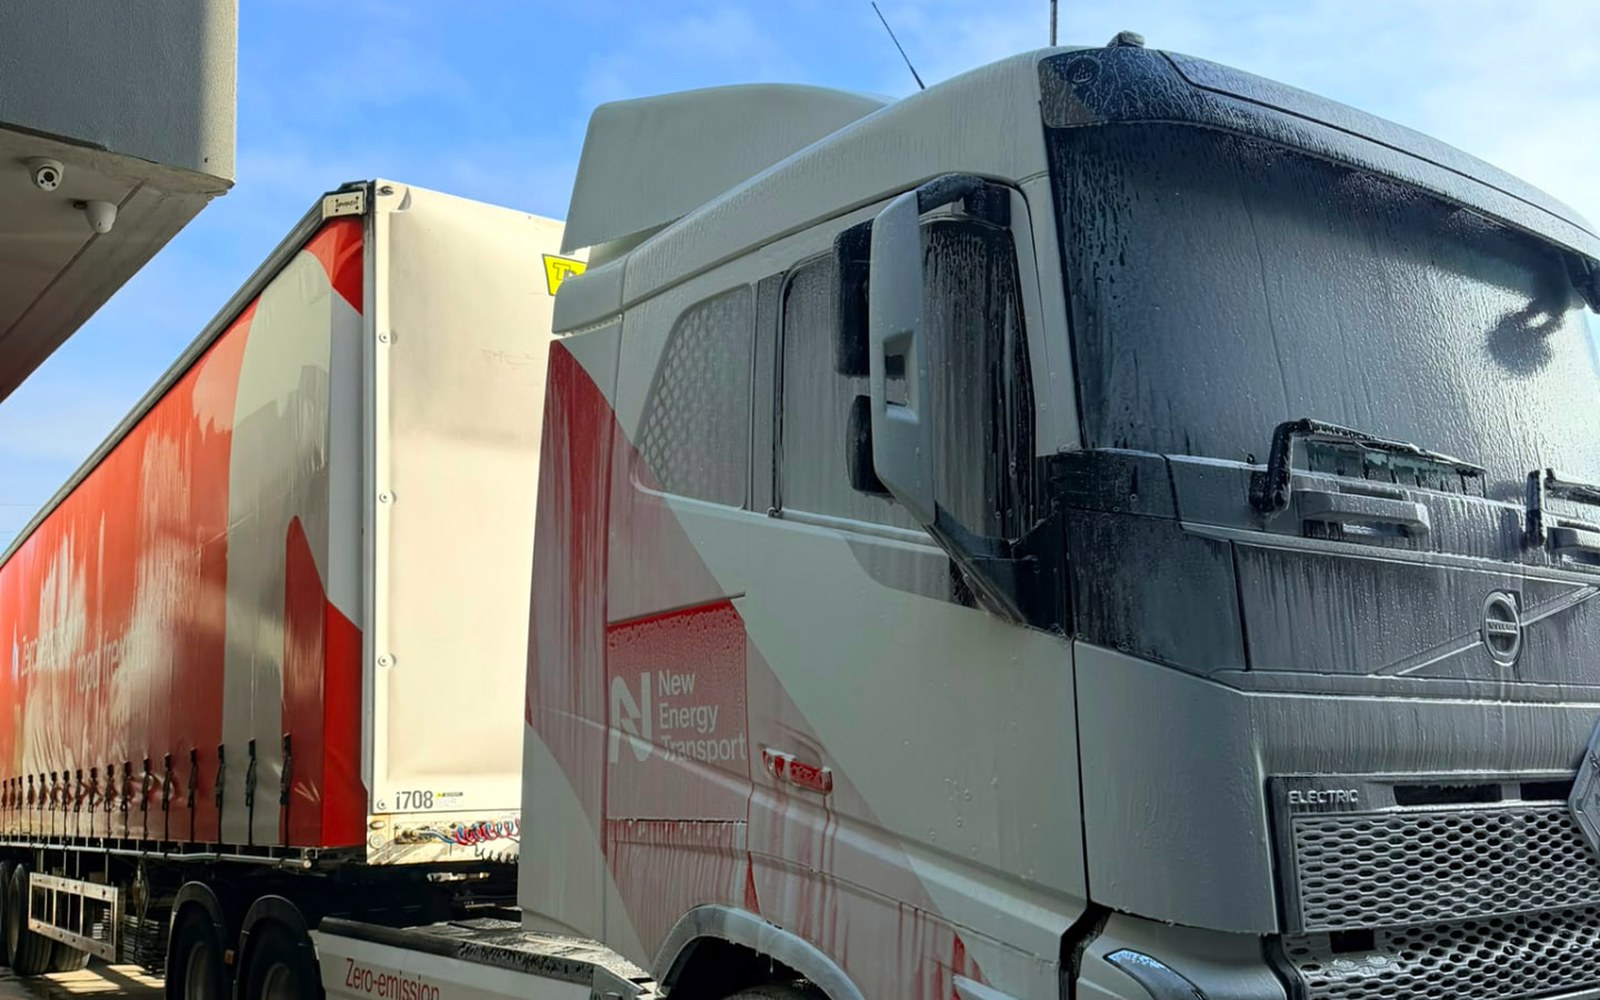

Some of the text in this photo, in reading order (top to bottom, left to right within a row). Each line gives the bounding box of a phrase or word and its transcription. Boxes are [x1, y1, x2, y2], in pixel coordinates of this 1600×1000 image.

[658, 669, 696, 696] New
[659, 702, 719, 733] Energy
[660, 732, 747, 763] Transport
[395, 789, 434, 810] i708
[1288, 789, 1359, 804] ELECTRIC
[345, 957, 440, 1000] Zero-emission
